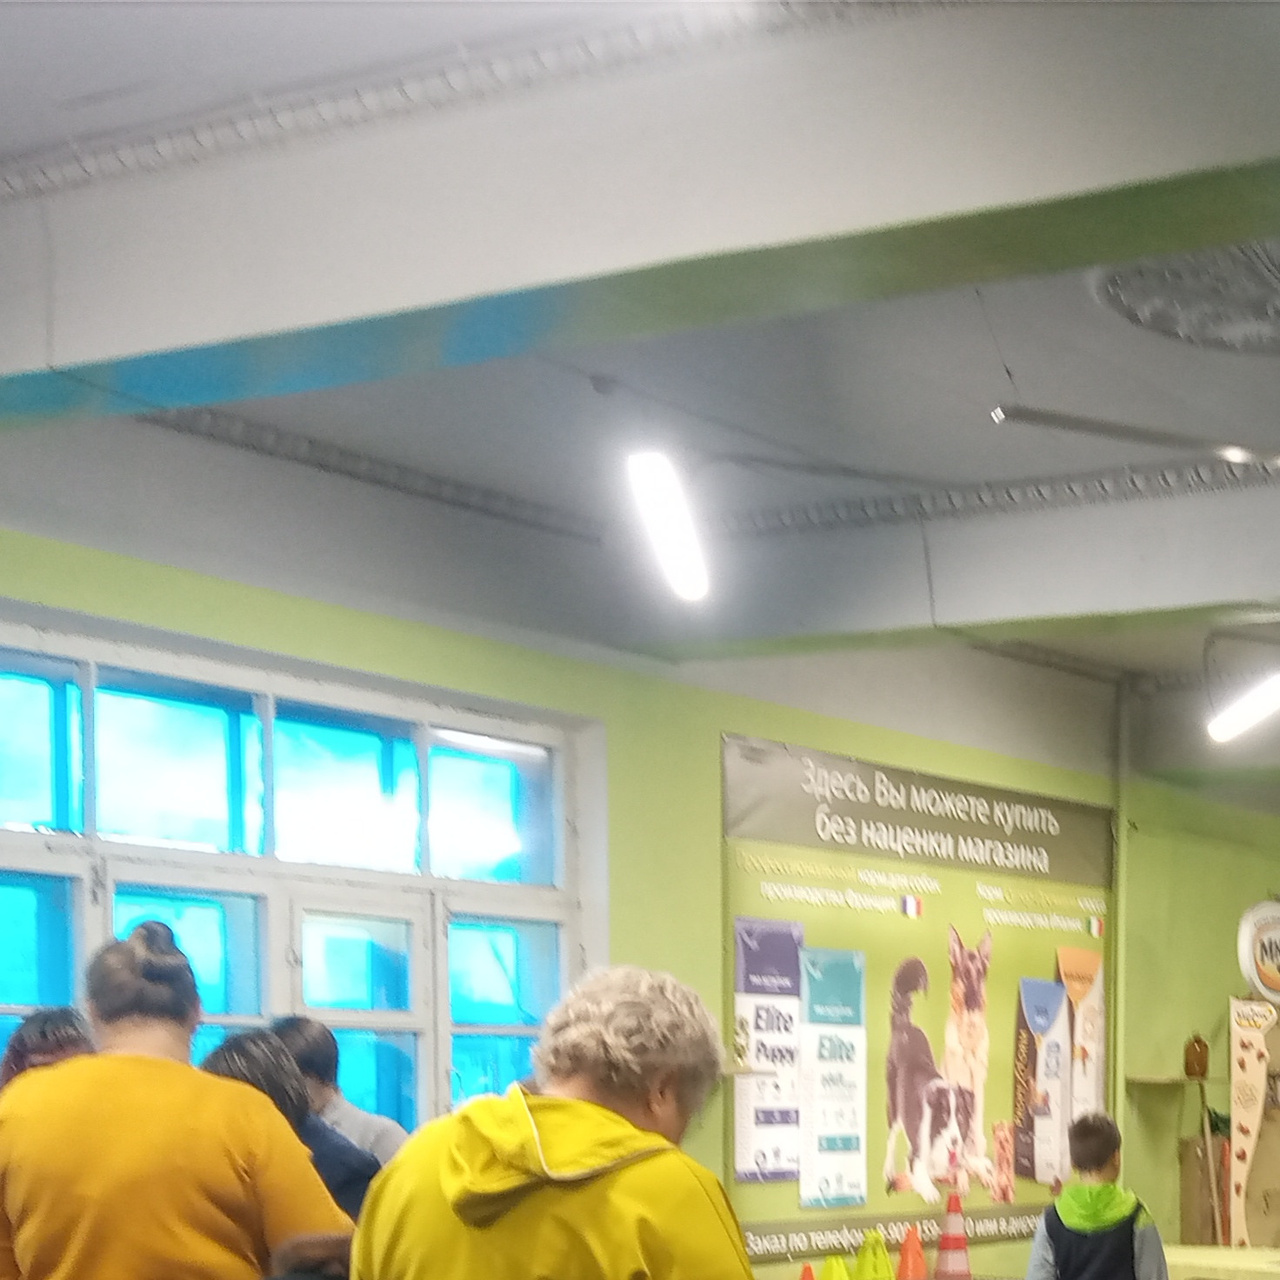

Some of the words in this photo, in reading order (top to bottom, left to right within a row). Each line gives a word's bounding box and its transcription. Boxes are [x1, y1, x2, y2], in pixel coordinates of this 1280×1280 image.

[800, 756, 870, 804] Здесь
[874, 770, 906, 811] Вы
[910, 783, 990, 825] можете
[993, 800, 1060, 836] купить
[815, 803, 858, 845] без
[861, 818, 955, 860] наценки
[958, 835, 1050, 875] магазина
[754, 1003, 794, 1033] Elite
[818, 1034, 857, 1063] Elite
[745, 1231, 788, 1256] Заказ
[809, 1224, 866, 1252] телефон
